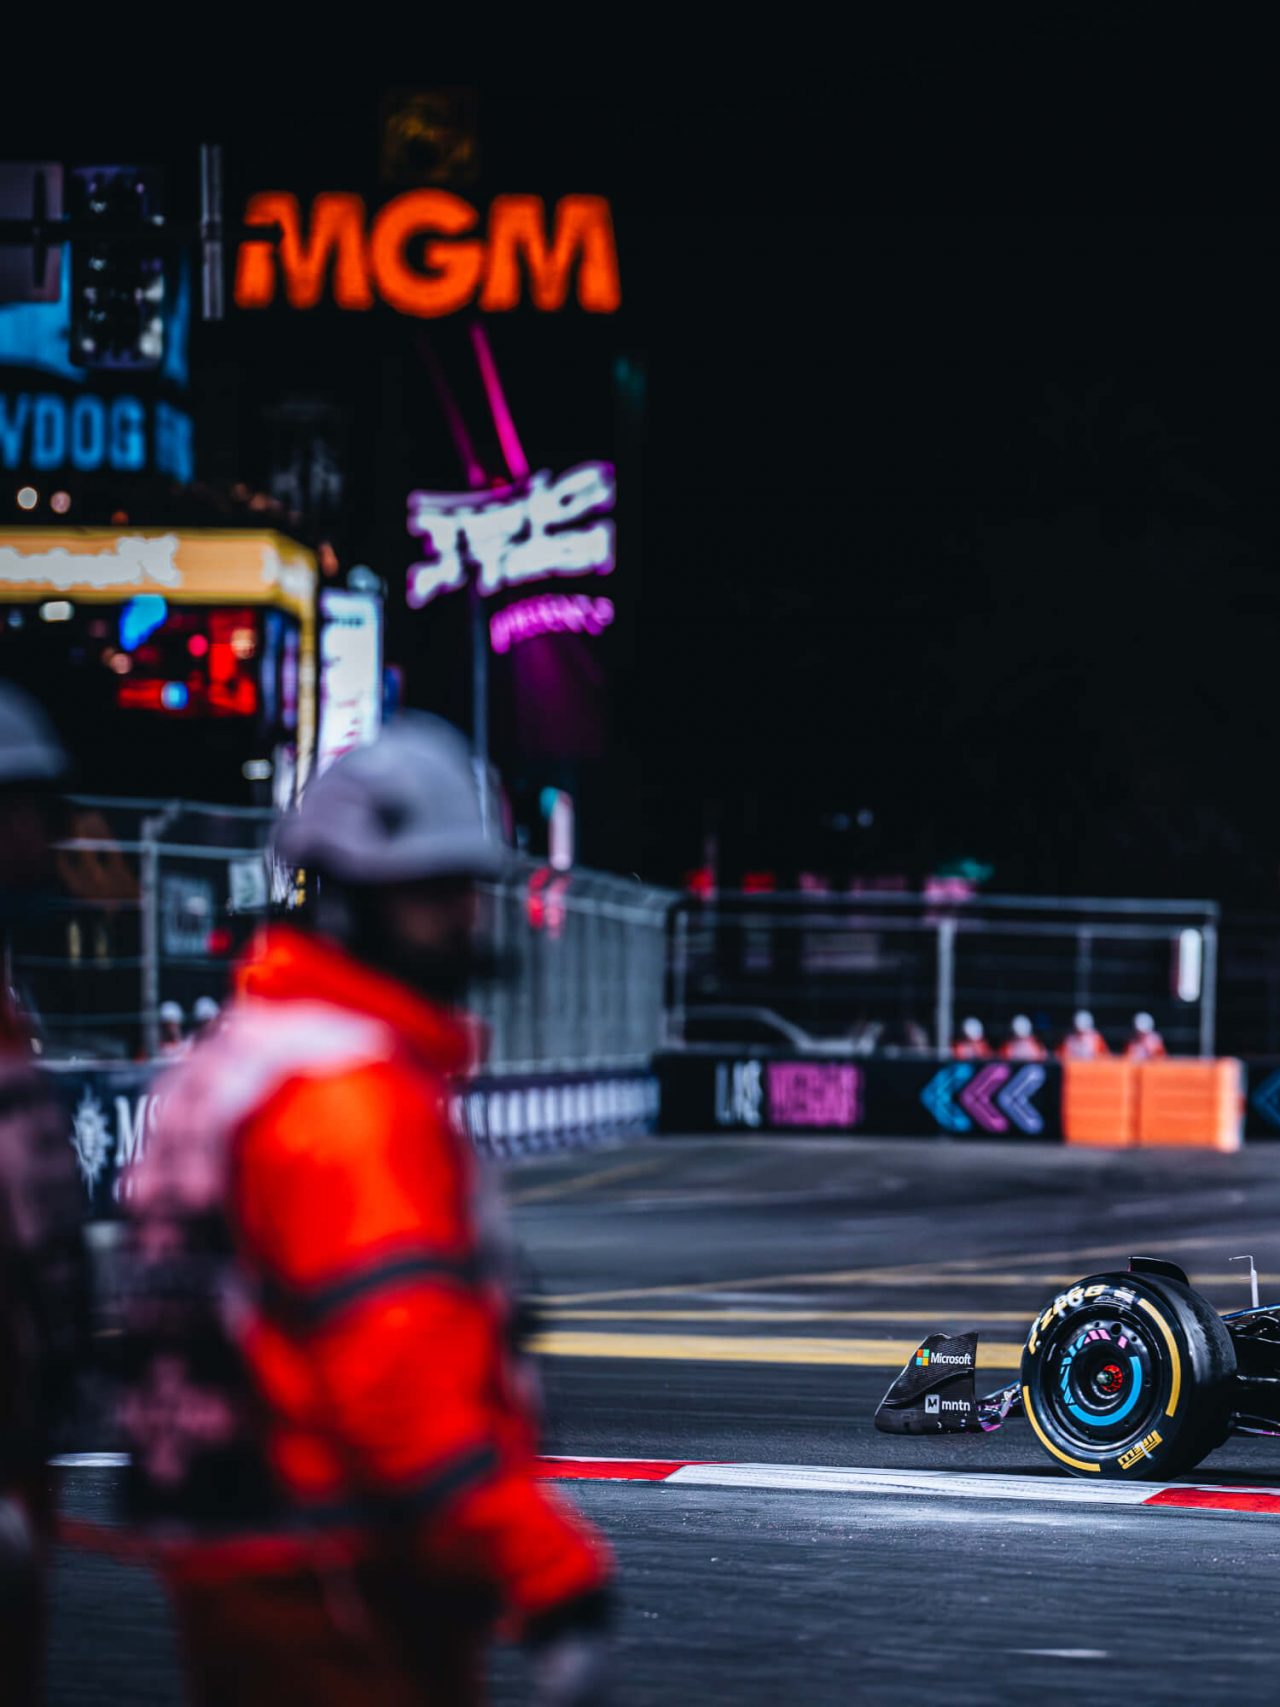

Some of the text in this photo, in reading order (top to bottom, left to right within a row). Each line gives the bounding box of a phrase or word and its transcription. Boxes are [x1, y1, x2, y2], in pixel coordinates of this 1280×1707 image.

[234, 189, 621, 318] MGM
[930, 1352, 972, 1365] Microsoft
[941, 1400, 971, 1412] mntn
[1117, 1430, 1163, 1470] PIRELLI
